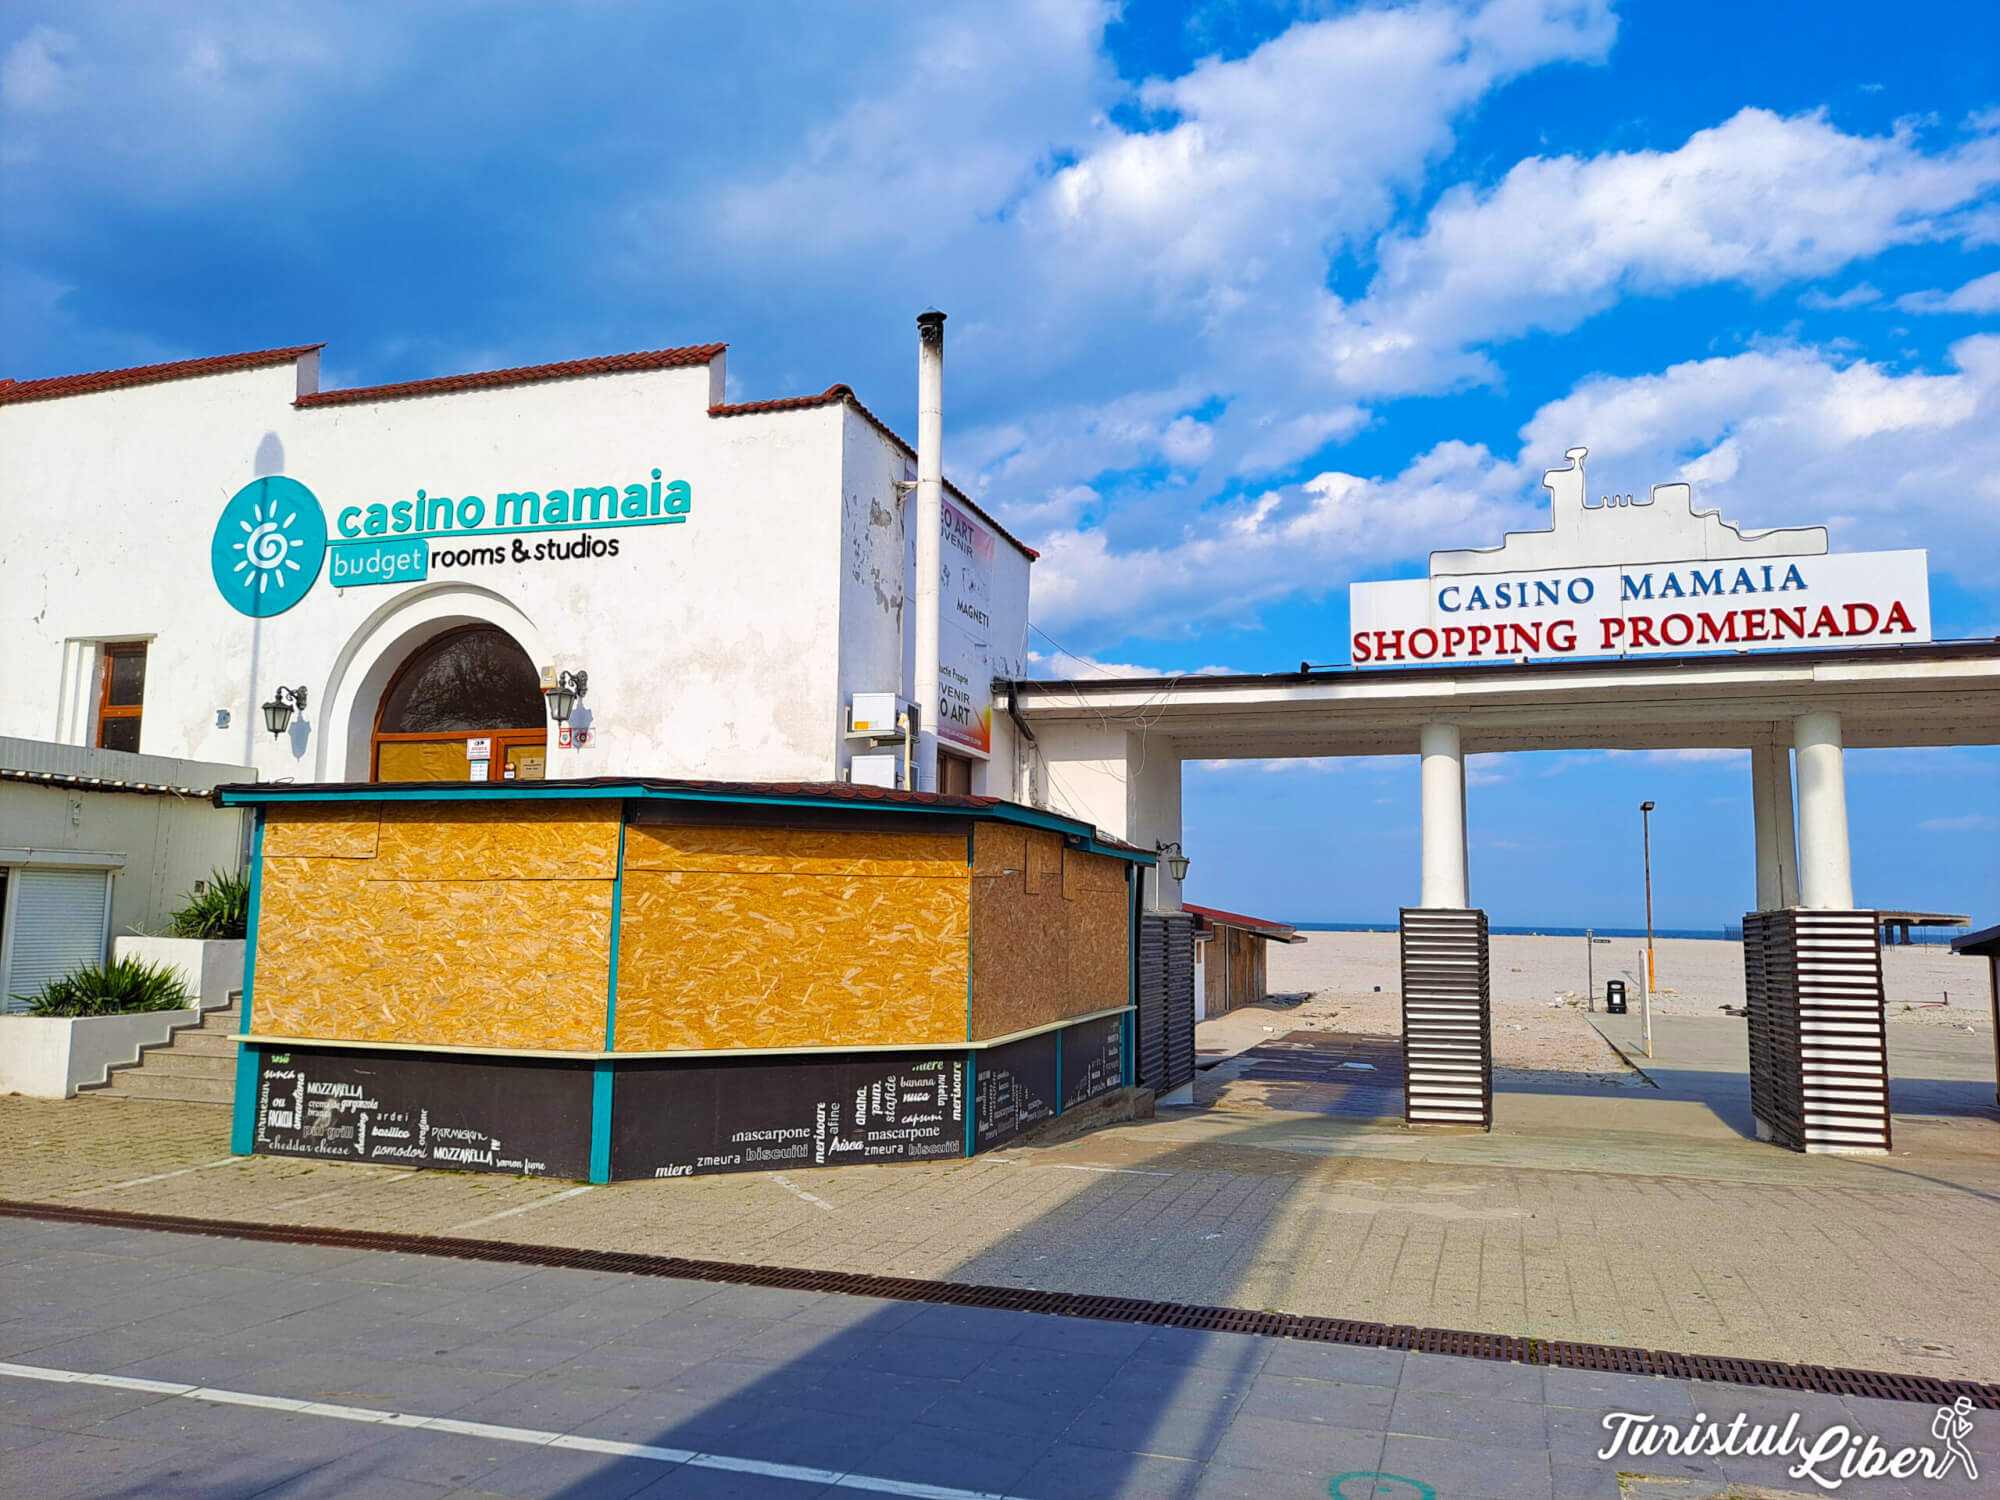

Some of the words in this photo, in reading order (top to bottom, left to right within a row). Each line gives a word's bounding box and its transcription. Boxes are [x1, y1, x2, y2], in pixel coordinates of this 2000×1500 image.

[337, 489, 485, 538] casino
[495, 468, 692, 526] mamaia
[954, 518, 975, 546] ART
[334, 547, 421, 582] budget
[431, 546, 505, 569] rooms
[1437, 576, 1595, 613] CASINO
[1620, 563, 1809, 602] MAMAIA
[957, 598, 989, 628] MAGNETI
[1351, 619, 1577, 664] SHOPPING
[1600, 600, 1918, 651] PROMENADA
[951, 704, 971, 727] ART
[307, 1082, 364, 1102] MOZZARELLA
[900, 1076, 936, 1088] banana
[937, 1074, 949, 1107] nutella
[950, 1061, 962, 1121] merisoare
[885, 1075, 897, 1123] stafide
[376, 1112, 409, 1122] ardei
[828, 1102, 840, 1135] afine
[901, 1110, 943, 1127] capsuni
[268, 1134, 313, 1152] cheddar
[314, 1137, 351, 1155] cheese
[731, 1127, 811, 1144] mascarpone
[813, 1102, 826, 1164] merisoare
[868, 1127, 941, 1141] mascarpone
[371, 1144, 428, 1159] pomodori
[433, 1146, 493, 1166] MOZZARELLA
[828, 1136, 864, 1156] frisca
[864, 1143, 904, 1156] zmeura
[908, 1140, 960, 1156] biscuiti
[655, 1163, 694, 1178] miere
[697, 1153, 741, 1167] zmeura
[746, 1144, 809, 1161] biscuiti
